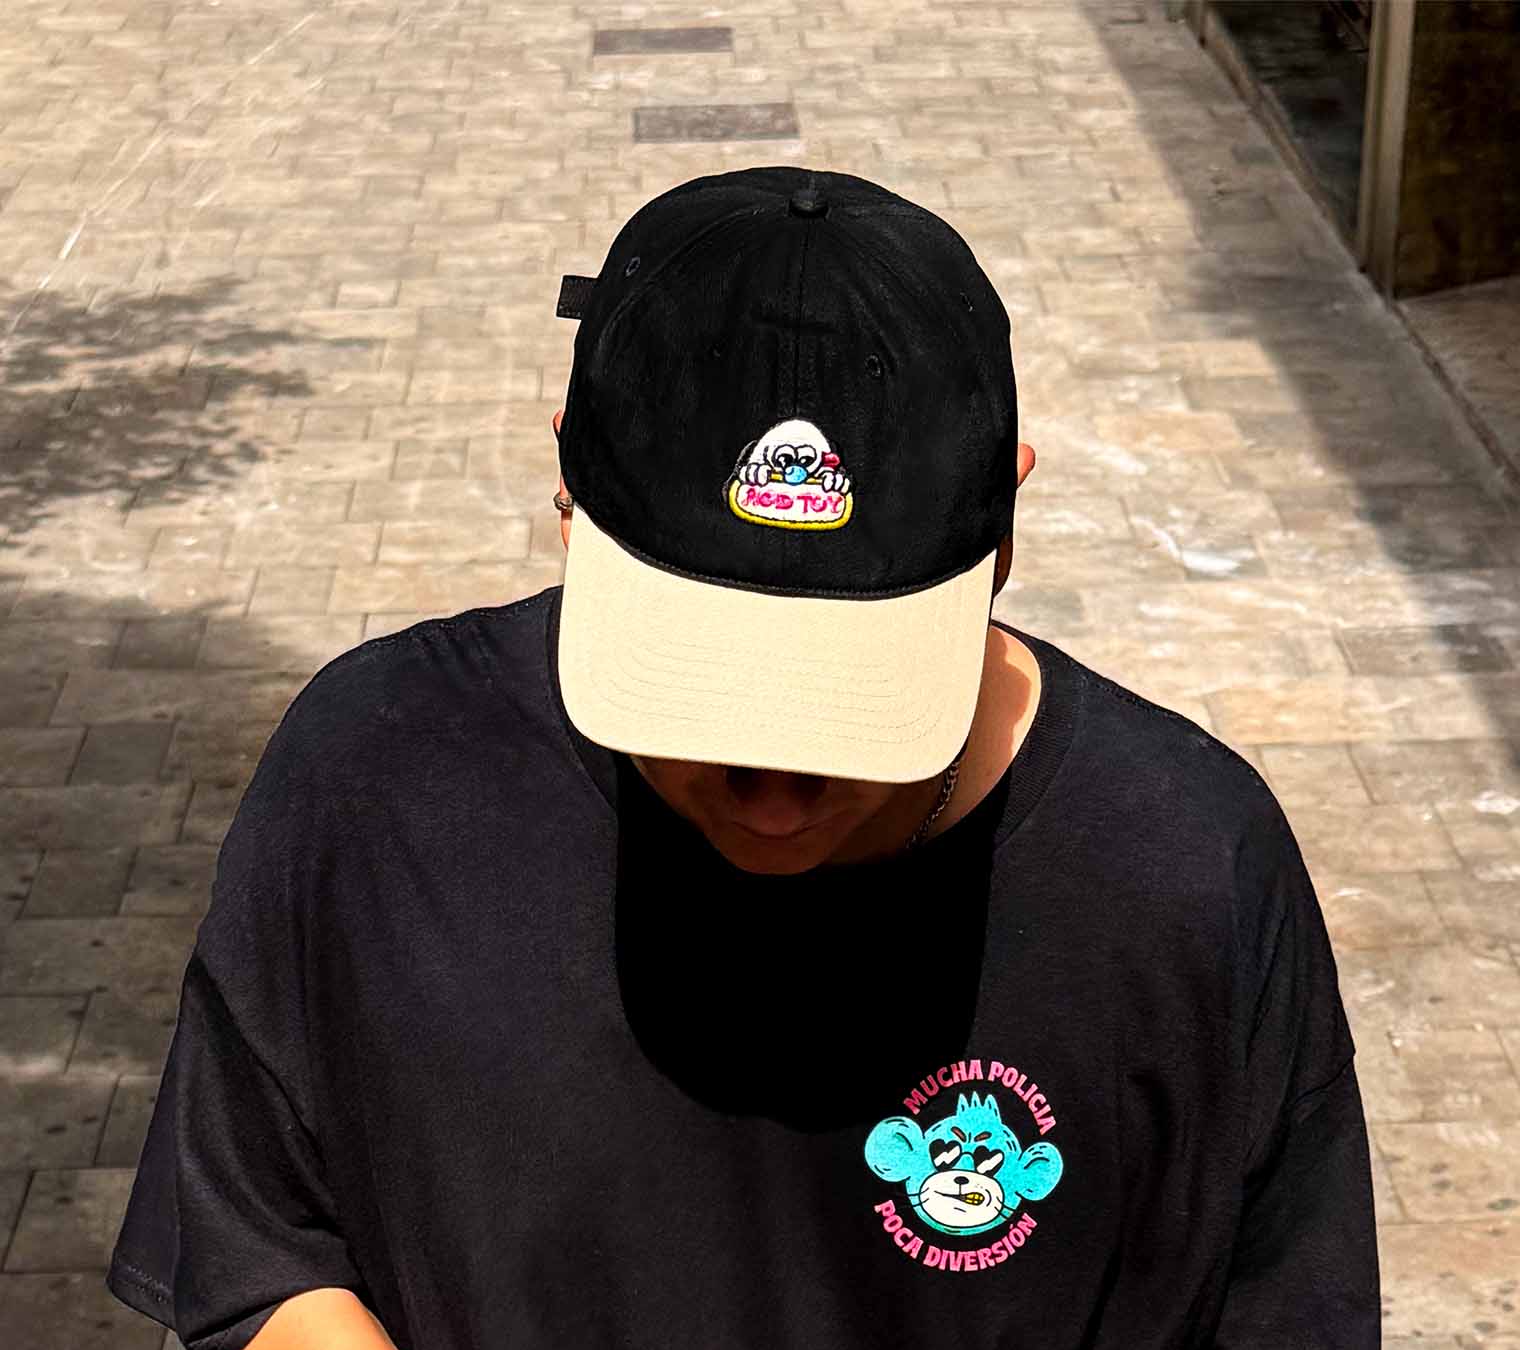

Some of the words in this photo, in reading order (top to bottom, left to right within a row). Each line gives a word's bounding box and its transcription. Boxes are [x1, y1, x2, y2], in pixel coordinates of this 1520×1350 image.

[796, 495, 844, 513] TOY
[903, 1059, 984, 1115] MUCHA
[988, 1060, 1057, 1136] POLICIA
[874, 1199, 924, 1259] POCA
[923, 1212, 1038, 1272] DIVERSIÓN
